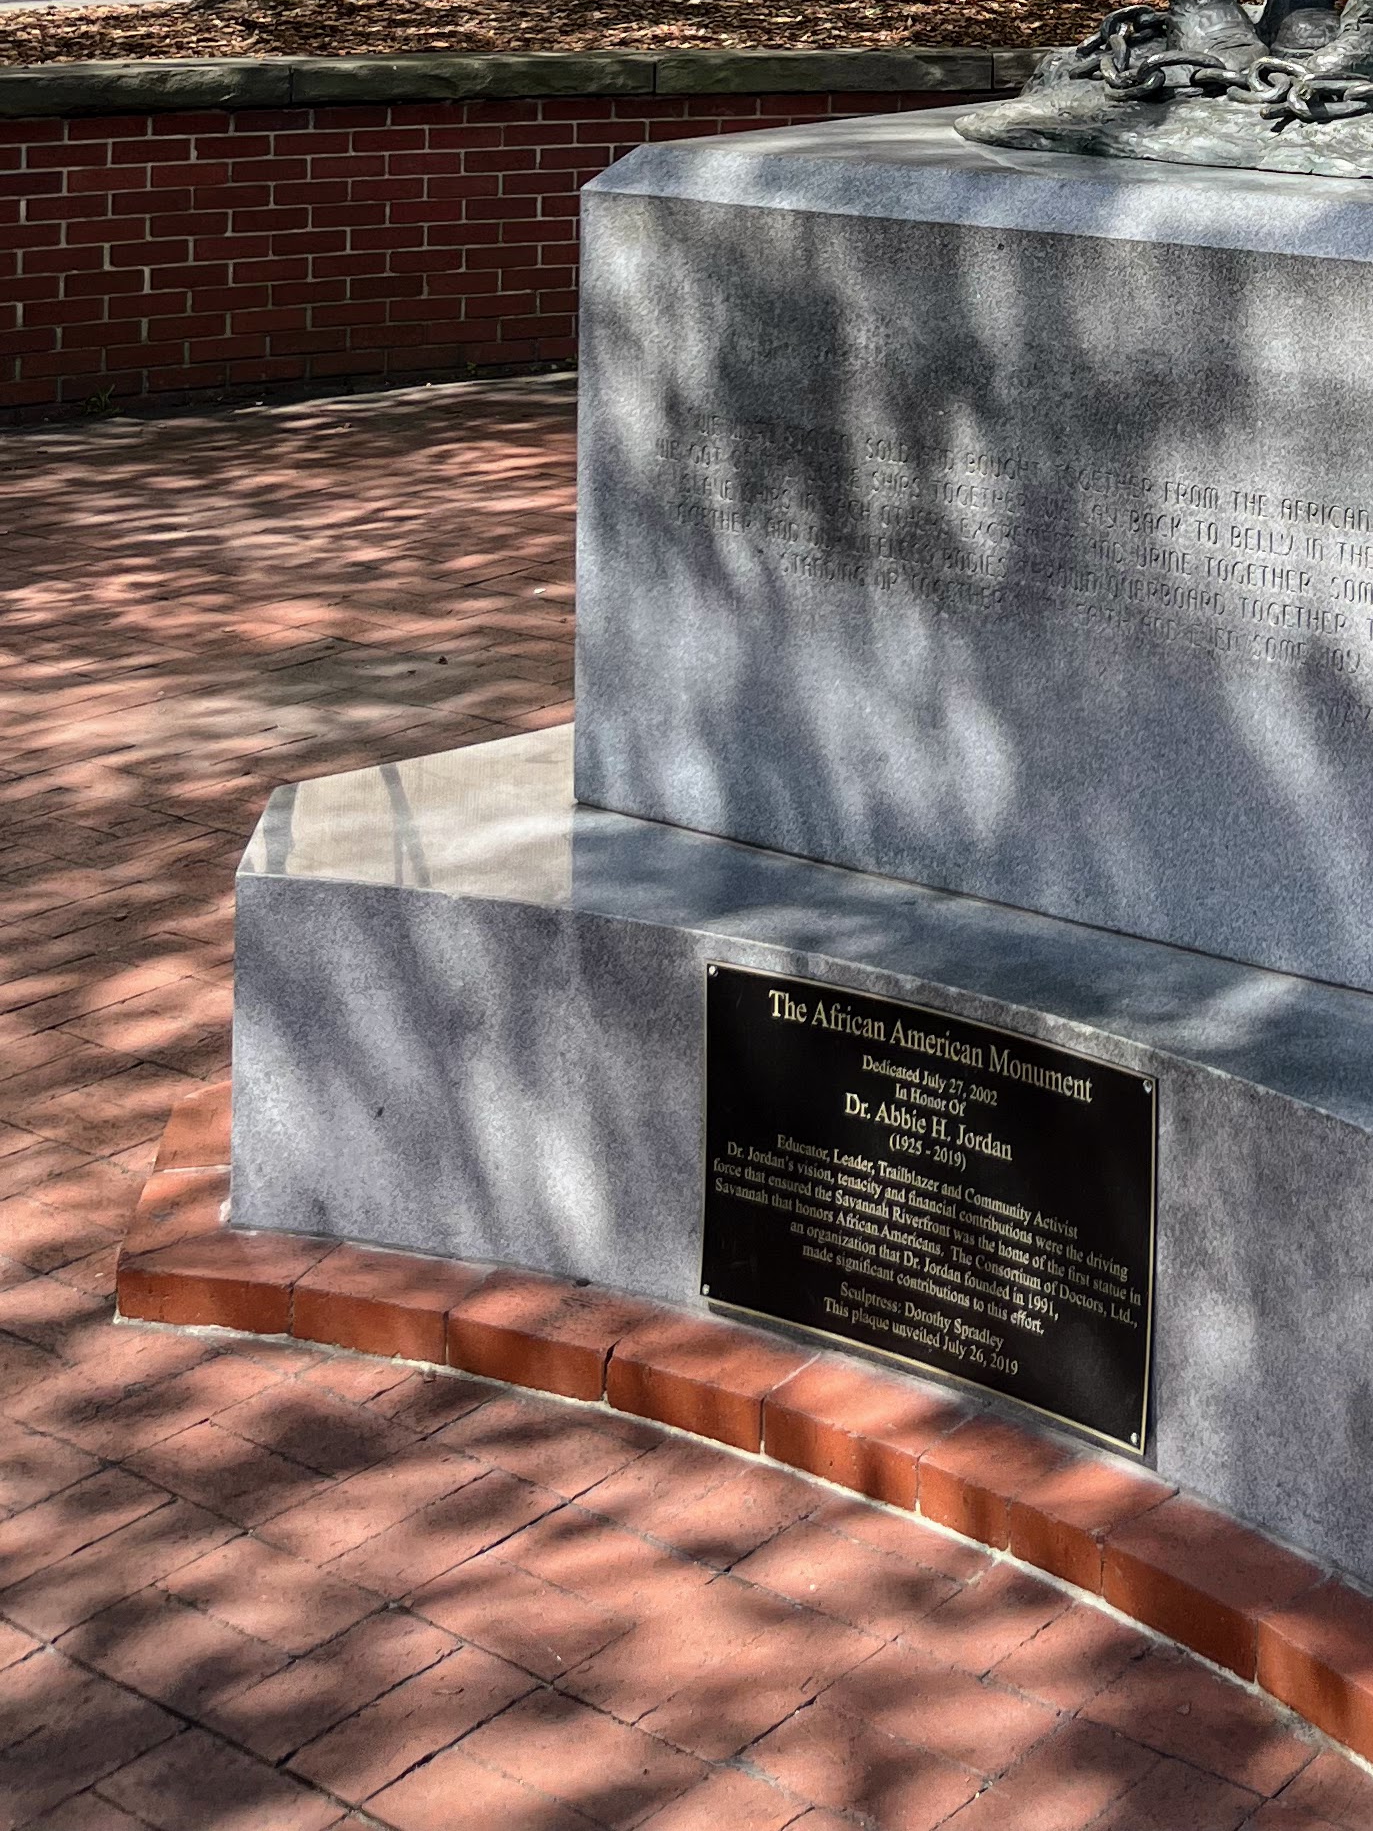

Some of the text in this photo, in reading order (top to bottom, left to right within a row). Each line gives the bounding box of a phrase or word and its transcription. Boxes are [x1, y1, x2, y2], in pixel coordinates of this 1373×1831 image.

[865, 436, 907, 465] SOLD
[1163, 480, 1218, 510] FROM
[1231, 490, 1268, 518] THE
[1280, 497, 1370, 533] AFRICAN
[1130, 509, 1180, 539] BACK
[1195, 518, 1218, 545] TO
[1230, 524, 1293, 557] BELLY
[1306, 536, 1323, 561] IN
[1137, 545, 1192, 576] URINE
[1204, 556, 1310, 596] TOGETHER
[1108, 575, 1226, 617] OVERBOARD
[1238, 596, 1346, 638] TOGETHER
[768, 989, 1092, 1103] The African American Monument
[862, 1054, 997, 1106] Dedicated July 27, 2002
[844, 1092, 1012, 1160] Dr. Abbie H. Jordan
[895, 1083, 966, 1116] In Honor Of
[777, 1133, 1077, 1239] Educator, Leader, Trailblazer and Community Activist
[889, 1133, 922, 1154] (1925
[933, 1145, 966, 1171] 2019)
[713, 1157, 1141, 1306] force that ensured the Savannah Riverfront was the home of the first statue in
[715, 1177, 768, 1204] Savannah
[771, 1193, 792, 1210] that
[795, 1198, 833, 1222] honors
[835, 1210, 879, 1235] African
[950, 1245, 972, 1265] The
[975, 1256, 1041, 1290] Consortium
[1043, 1280, 1058, 1295] of
[1059, 1283, 1106, 1316] Doctors,
[727, 1141, 1128, 1282] Dr. Jordan's vision, tenacity and financial contributions were the driving
[790, 1221, 1058, 1320] an organization that Dr. Jordan founded in 1991,
[802, 1245, 833, 1262] made
[836, 1253, 893, 1281] significant
[896, 1273, 969, 1307] contributions
[973, 1297, 984, 1312] to
[987, 1301, 1007, 1320] this
[823, 1296, 1018, 1374] This plaque unveiled July 26, 2019
[840, 1281, 1003, 1351] Sculptress: Dorothy Spradley
